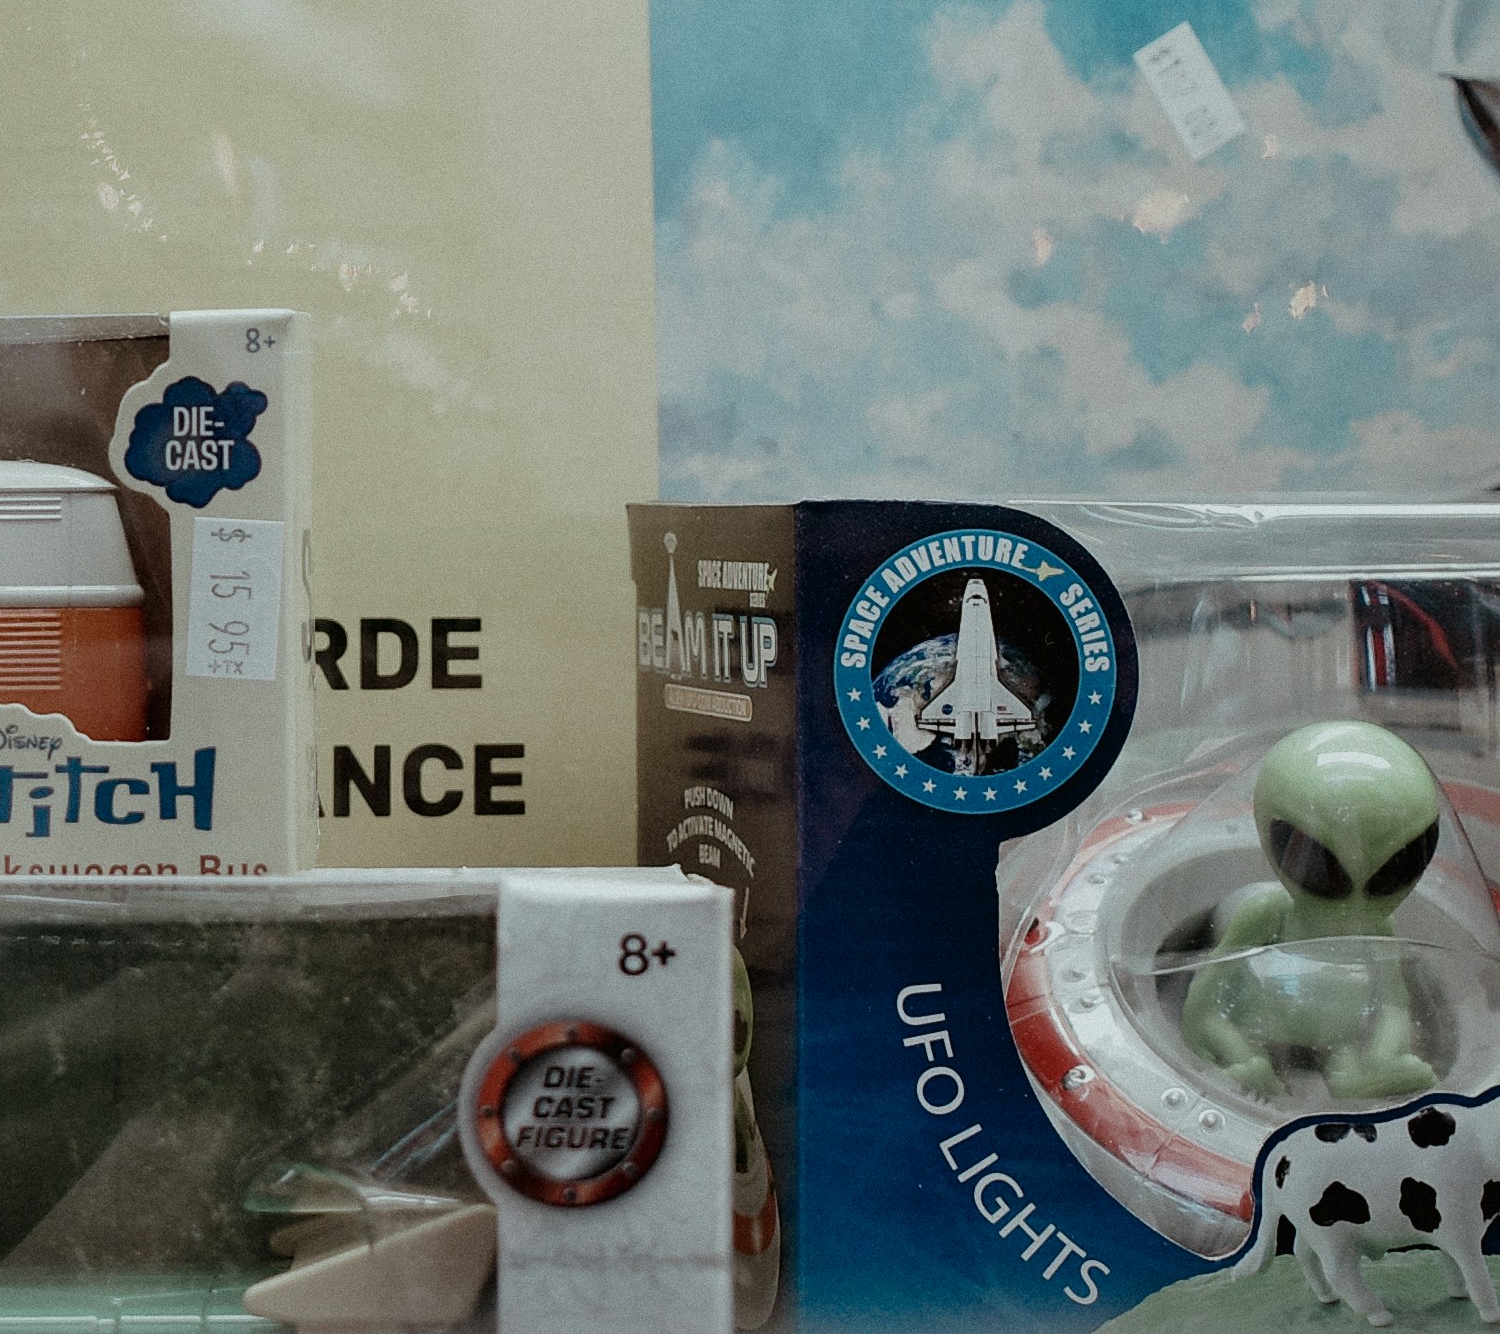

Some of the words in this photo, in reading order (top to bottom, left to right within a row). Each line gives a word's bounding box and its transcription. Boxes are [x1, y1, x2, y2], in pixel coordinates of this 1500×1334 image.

[246, 327, 277, 353] 8+
[173, 405, 225, 438] DIE-
[165, 439, 235, 471] CAST
[840, 583, 891, 669] SPACE
[880, 534, 1030, 595] ADVENTURE
[1058, 582, 1111, 674] SERIES
[208, 620, 250, 655] 95
[712, 613, 735, 684] IT
[740, 614, 779, 689] UP
[320, 743, 526, 818] NCE
[706, 786, 734, 821] DOWN
[618, 933, 676, 975] 8+
[543, 1065, 604, 1089] DIE-
[532, 1095, 616, 1119] CAST
[515, 1126, 630, 1150] FIGURE
[895, 980, 969, 1119] UFO
[937, 1123, 1112, 1309] LIGHTS
